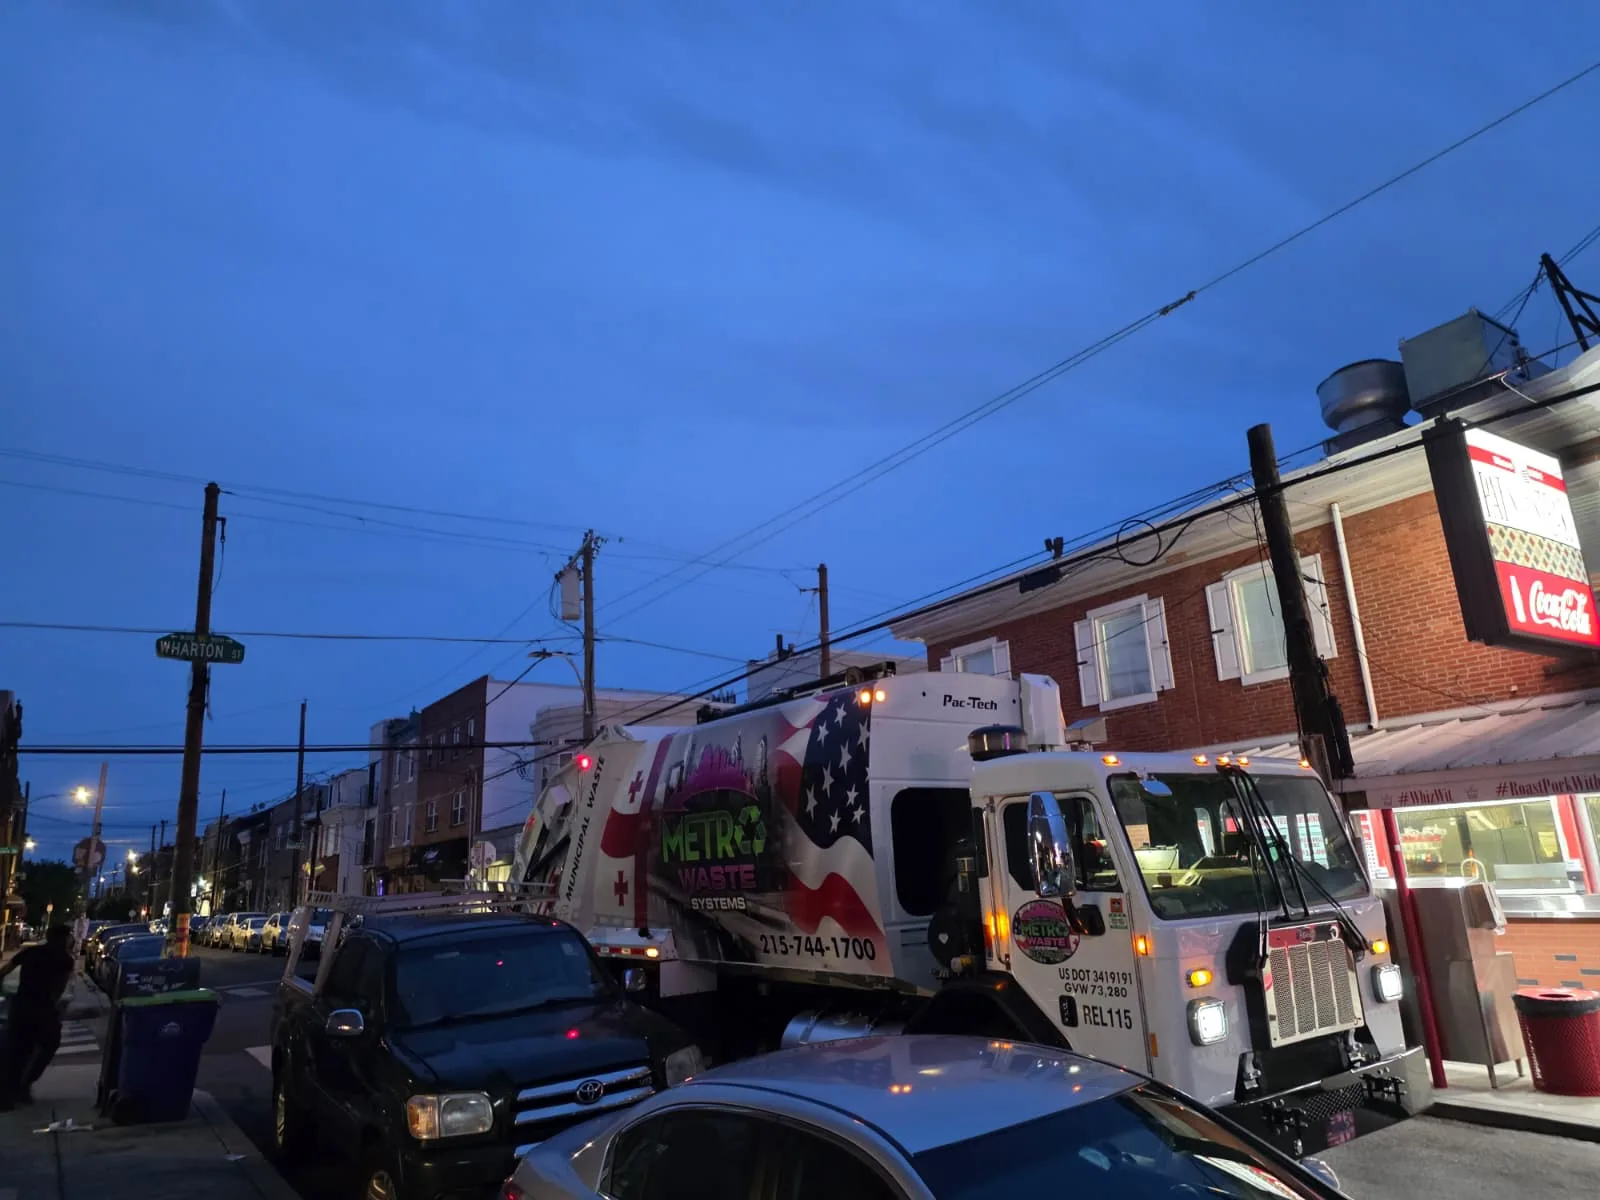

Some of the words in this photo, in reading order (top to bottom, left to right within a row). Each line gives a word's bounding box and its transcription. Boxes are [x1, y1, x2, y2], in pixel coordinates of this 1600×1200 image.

[160, 640, 224, 659] WHARTON
[943, 694, 998, 711] Pac-Tech
[565, 816, 591, 902] MUNICIPAL
[587, 755, 606, 809] WASTE
[678, 864, 757, 891] WASTE
[691, 896, 747, 910] SYSTEMS
[760, 934, 876, 960] 215-744-1700
[1058, 967, 1070, 980] US
[1071, 968, 1090, 982] DOT
[1092, 970, 1133, 985] 3419191
[1064, 982, 1089, 994] GVW
[1090, 984, 1128, 998] 73,280
[1082, 1004, 1133, 1030] REL115
